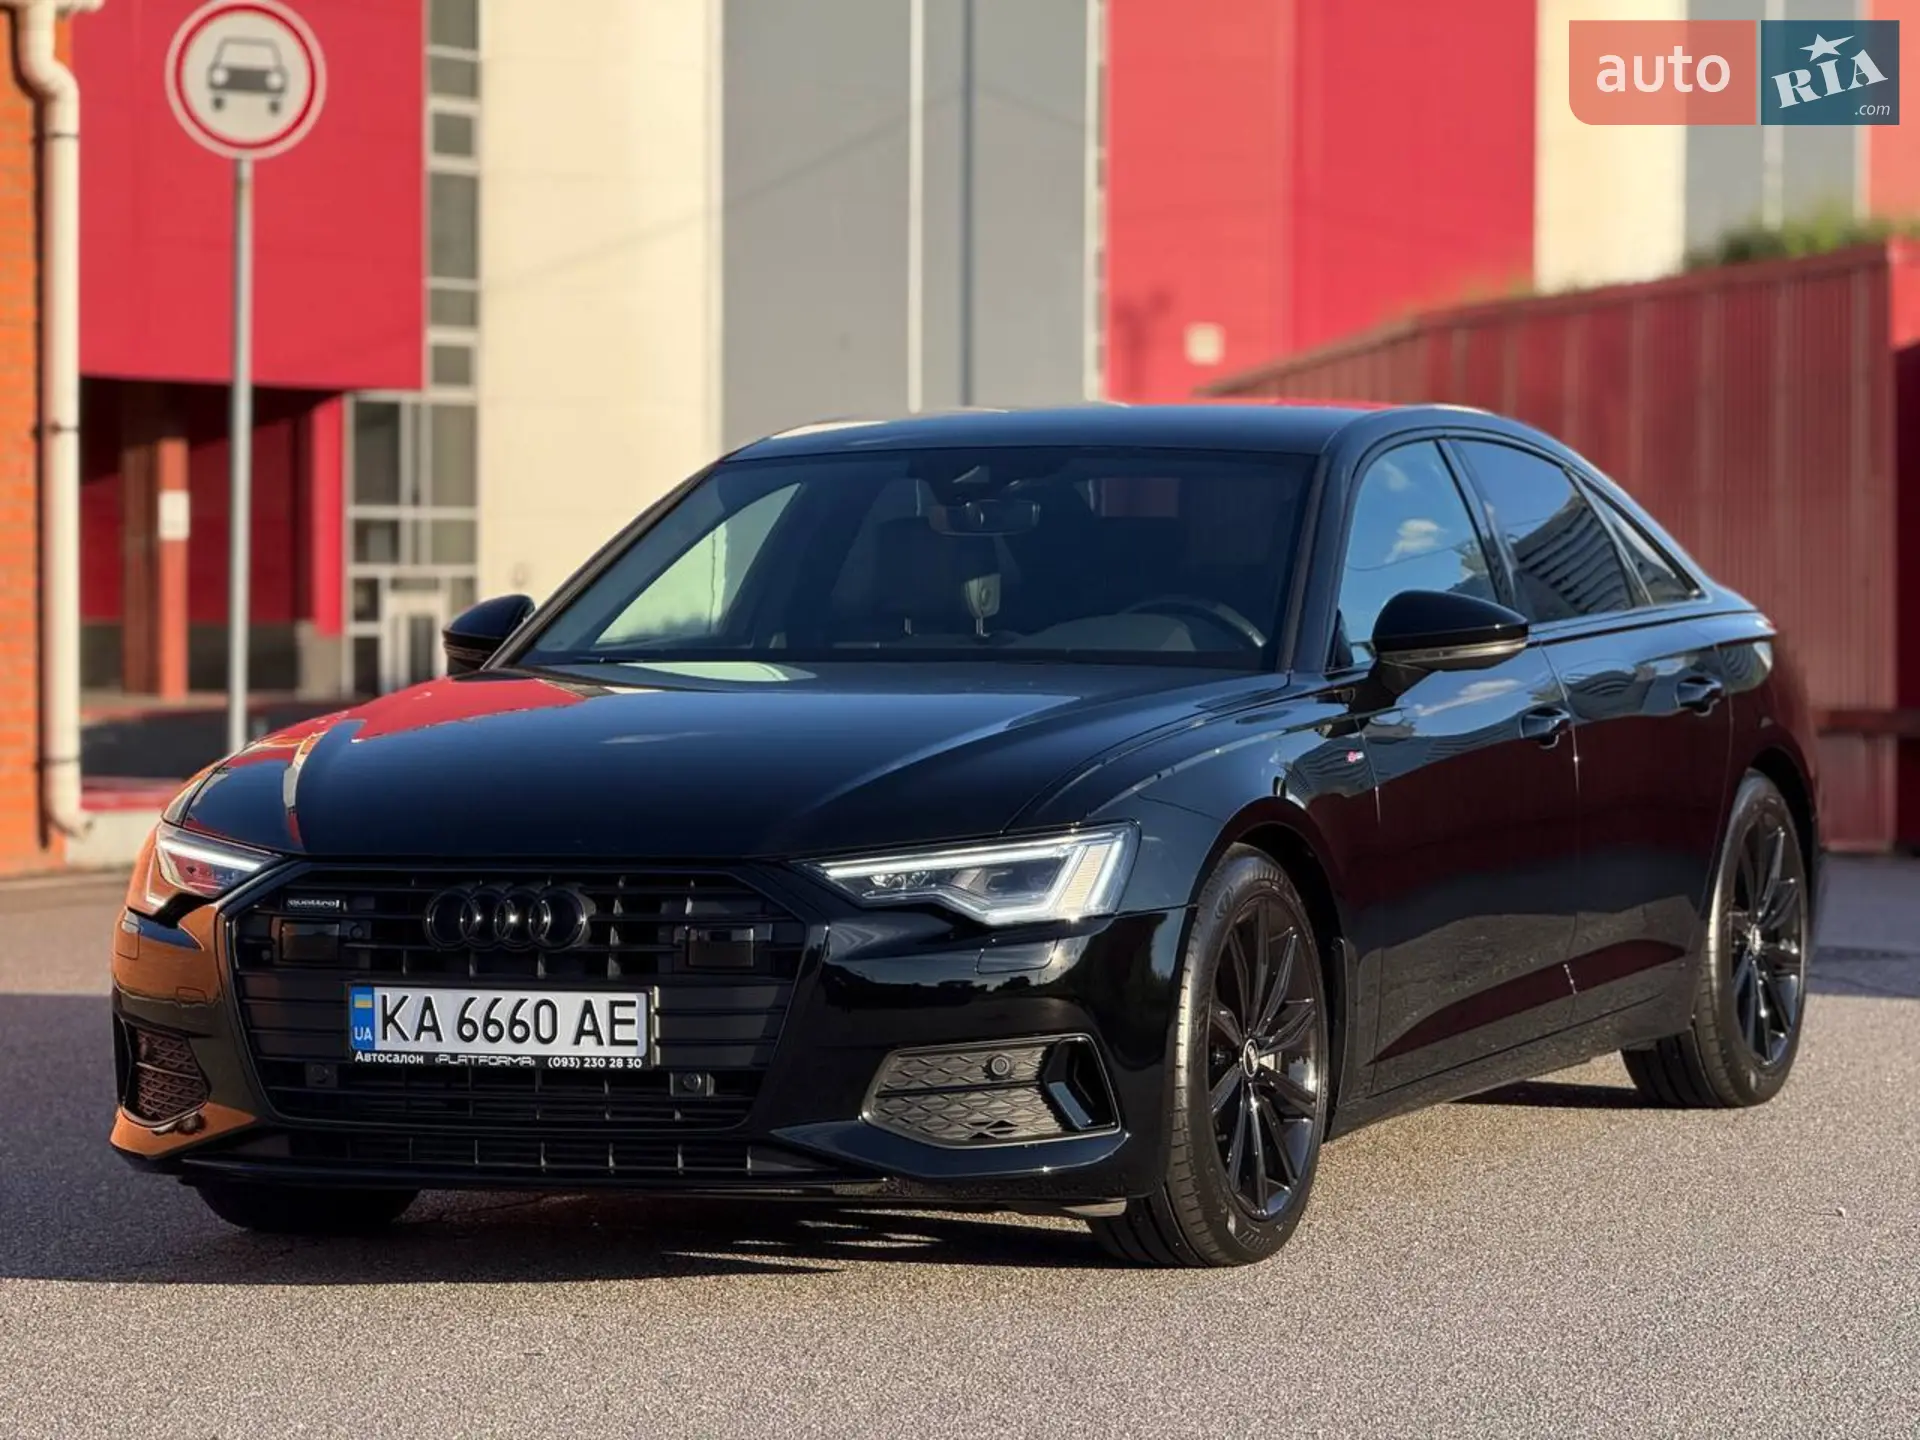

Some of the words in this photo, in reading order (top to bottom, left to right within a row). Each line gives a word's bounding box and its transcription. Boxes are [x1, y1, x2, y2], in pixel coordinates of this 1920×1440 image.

[381, 994, 443, 1044] KA
[456, 997, 558, 1045] 6660
[573, 999, 639, 1047] AE
[354, 1026, 373, 1042] UA
[354, 1050, 424, 1065] Автосалон
[547, 1056, 581, 1069] (093)
[583, 1057, 606, 1069] 230
[608, 1058, 623, 1069] 28
[626, 1058, 643, 1069] 30
